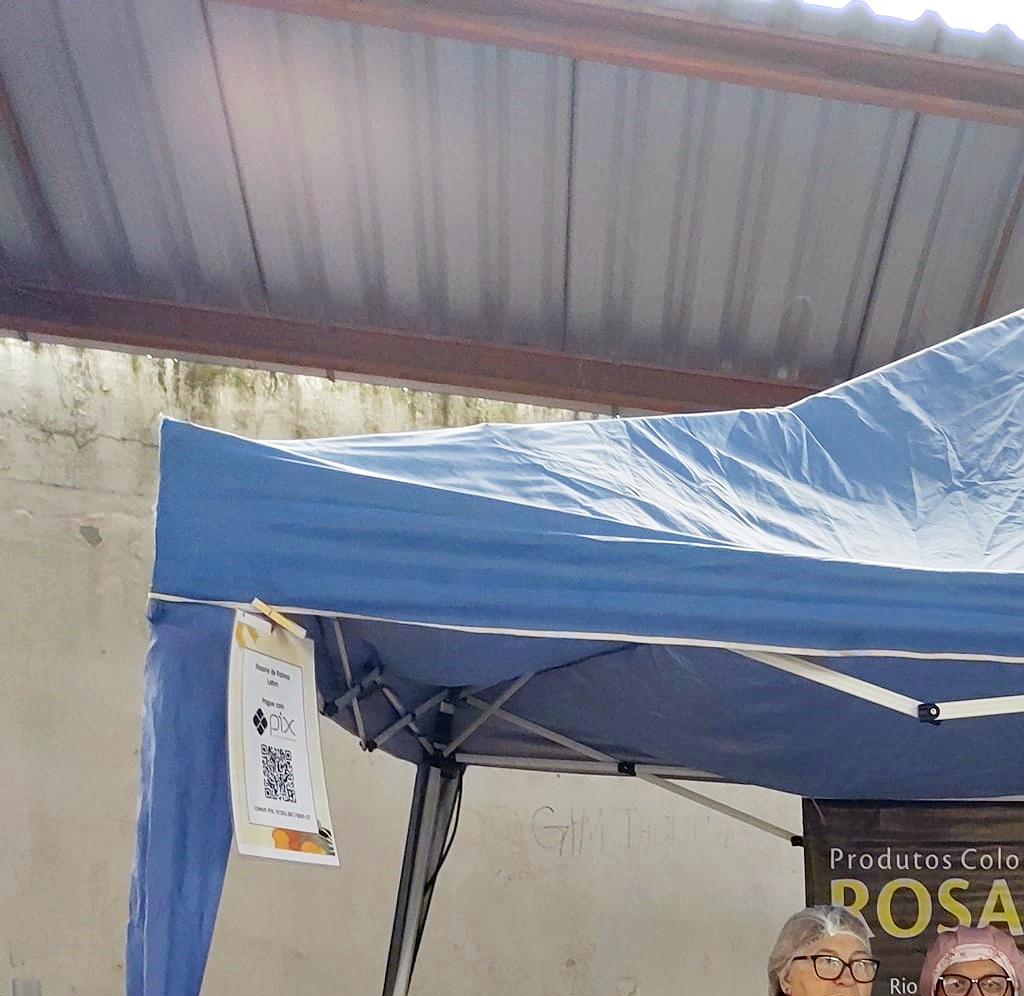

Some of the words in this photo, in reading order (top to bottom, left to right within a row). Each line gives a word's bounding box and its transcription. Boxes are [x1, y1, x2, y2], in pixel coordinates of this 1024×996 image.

[270, 712, 296, 736] pix
[830, 847, 952, 870] Produtos
[890, 978, 918, 995] Rio
